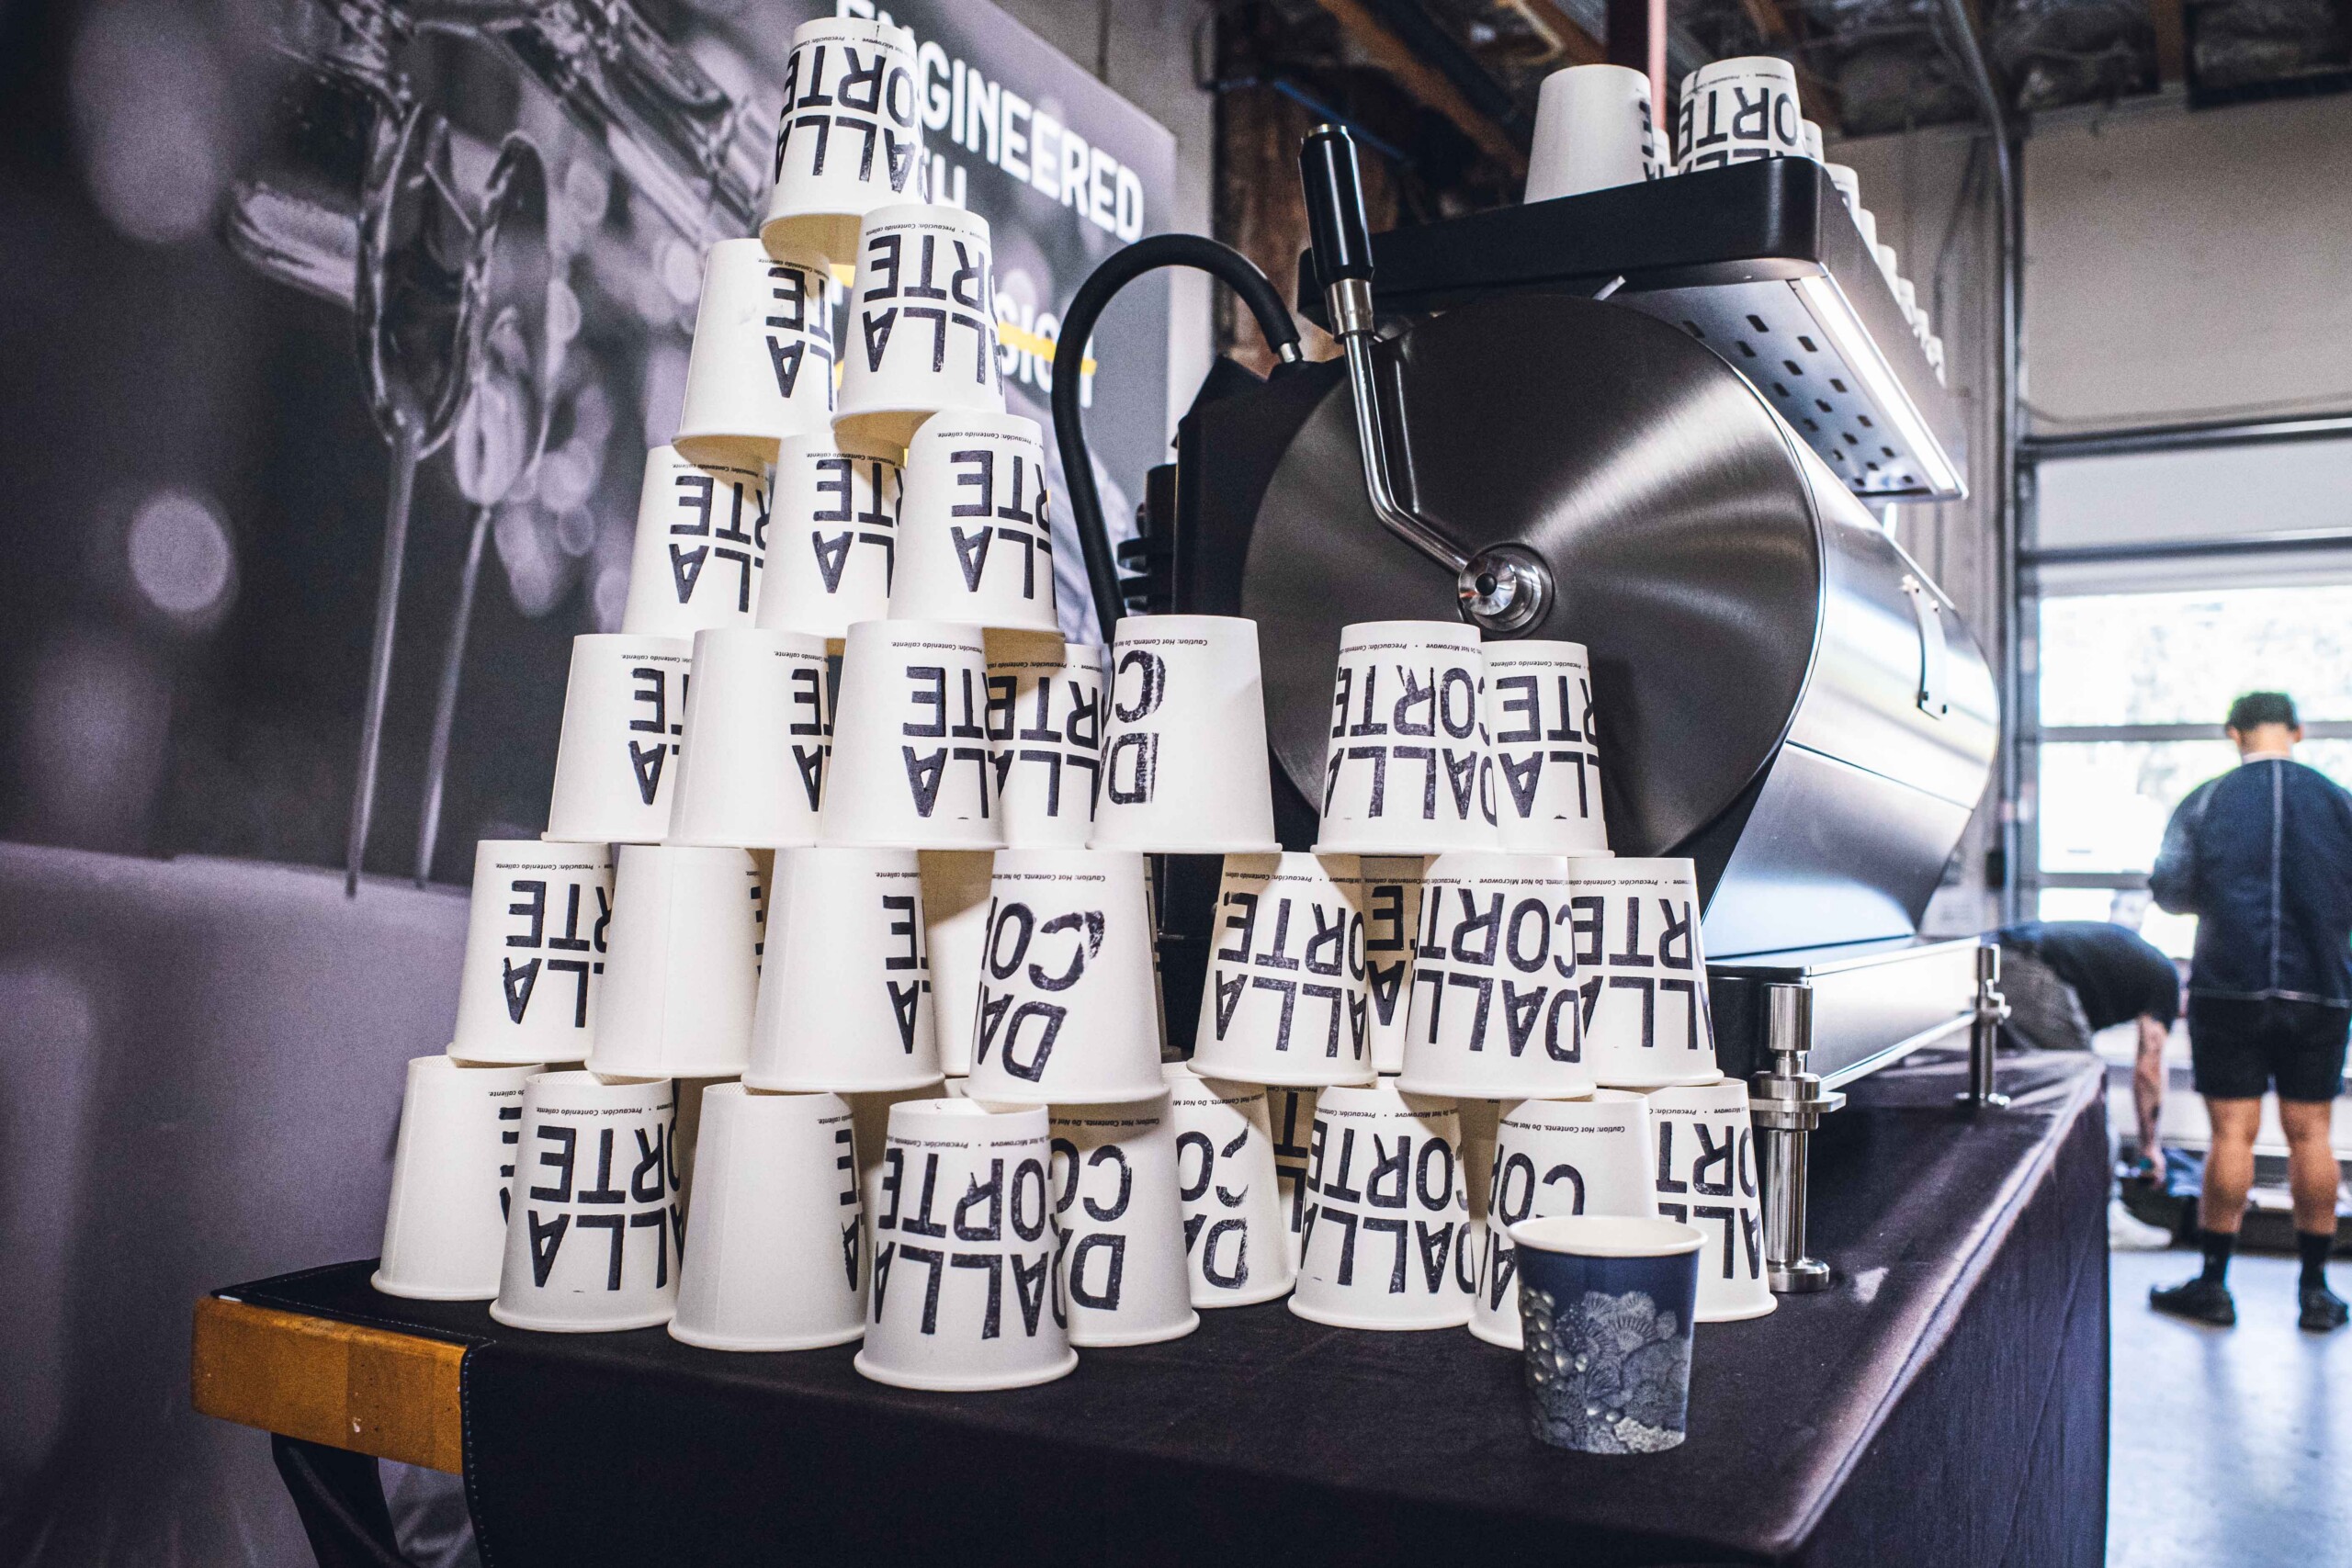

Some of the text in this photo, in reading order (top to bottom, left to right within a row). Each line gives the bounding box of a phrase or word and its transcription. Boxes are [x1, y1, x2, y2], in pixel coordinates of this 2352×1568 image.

[780, 46, 920, 128] ORTE
[836, 0, 1144, 243] GINEERED
[1679, 87, 1798, 160] ORTE
[775, 116, 930, 204] ALLA
[863, 234, 998, 321] RTE
[965, 432, 1000, 440] Contenido
[951, 450, 1050, 535] RTE
[671, 476, 771, 550] RTE
[951, 526, 1057, 610] LLA
[891, 641, 921, 649] caliente.
[922, 642, 956, 650] Contenido
[1162, 637, 1175, 646] Hot
[1177, 638, 1208, 647] Caution:
[1368, 643, 1408, 651] Precaución:
[1426, 643, 1461, 652] Microwave
[650, 655, 681, 664] Contenido
[1489, 660, 1517, 669] caliente.
[1519, 660, 1553, 669] Contenido
[1332, 665, 1490, 747] ORTE
[989, 676, 1105, 751] RTE
[1497, 676, 1600, 747] RTE
[1325, 746, 1498, 828] DALLA
[559, 863, 594, 872] Precaución:
[1076, 874, 1106, 883] Caution:
[1271, 874, 1312, 883] Precaución:
[1479, 877, 1519, 886] Microwave
[1217, 891, 1365, 982] ORTE
[1415, 886, 1577, 979] CORT
[1571, 897, 1702, 970] RTE
[1216, 970, 1369, 1061] ALLA
[1406, 969, 1581, 1064] DALL
[1580, 976, 1713, 1050] LLA
[560, 1108, 599, 1117] Contenido
[601, 1107, 642, 1117] Precaución:
[1340, 1111, 1376, 1120] Precaución:
[1395, 1111, 1430, 1119] Microwave
[1655, 1107, 1697, 1115] Precaución:
[1520, 1122, 1531, 1130] Not
[1581, 1125, 1595, 1134] Hot
[1597, 1125, 1625, 1134] Caution:
[924, 1140, 968, 1148] Precaución:
[990, 1139, 1028, 1148] Microwave
[1656, 1121, 1756, 1198] ORT
[1306, 1119, 1470, 1212] ORTE
[878, 1148, 1060, 1242] ORTE
